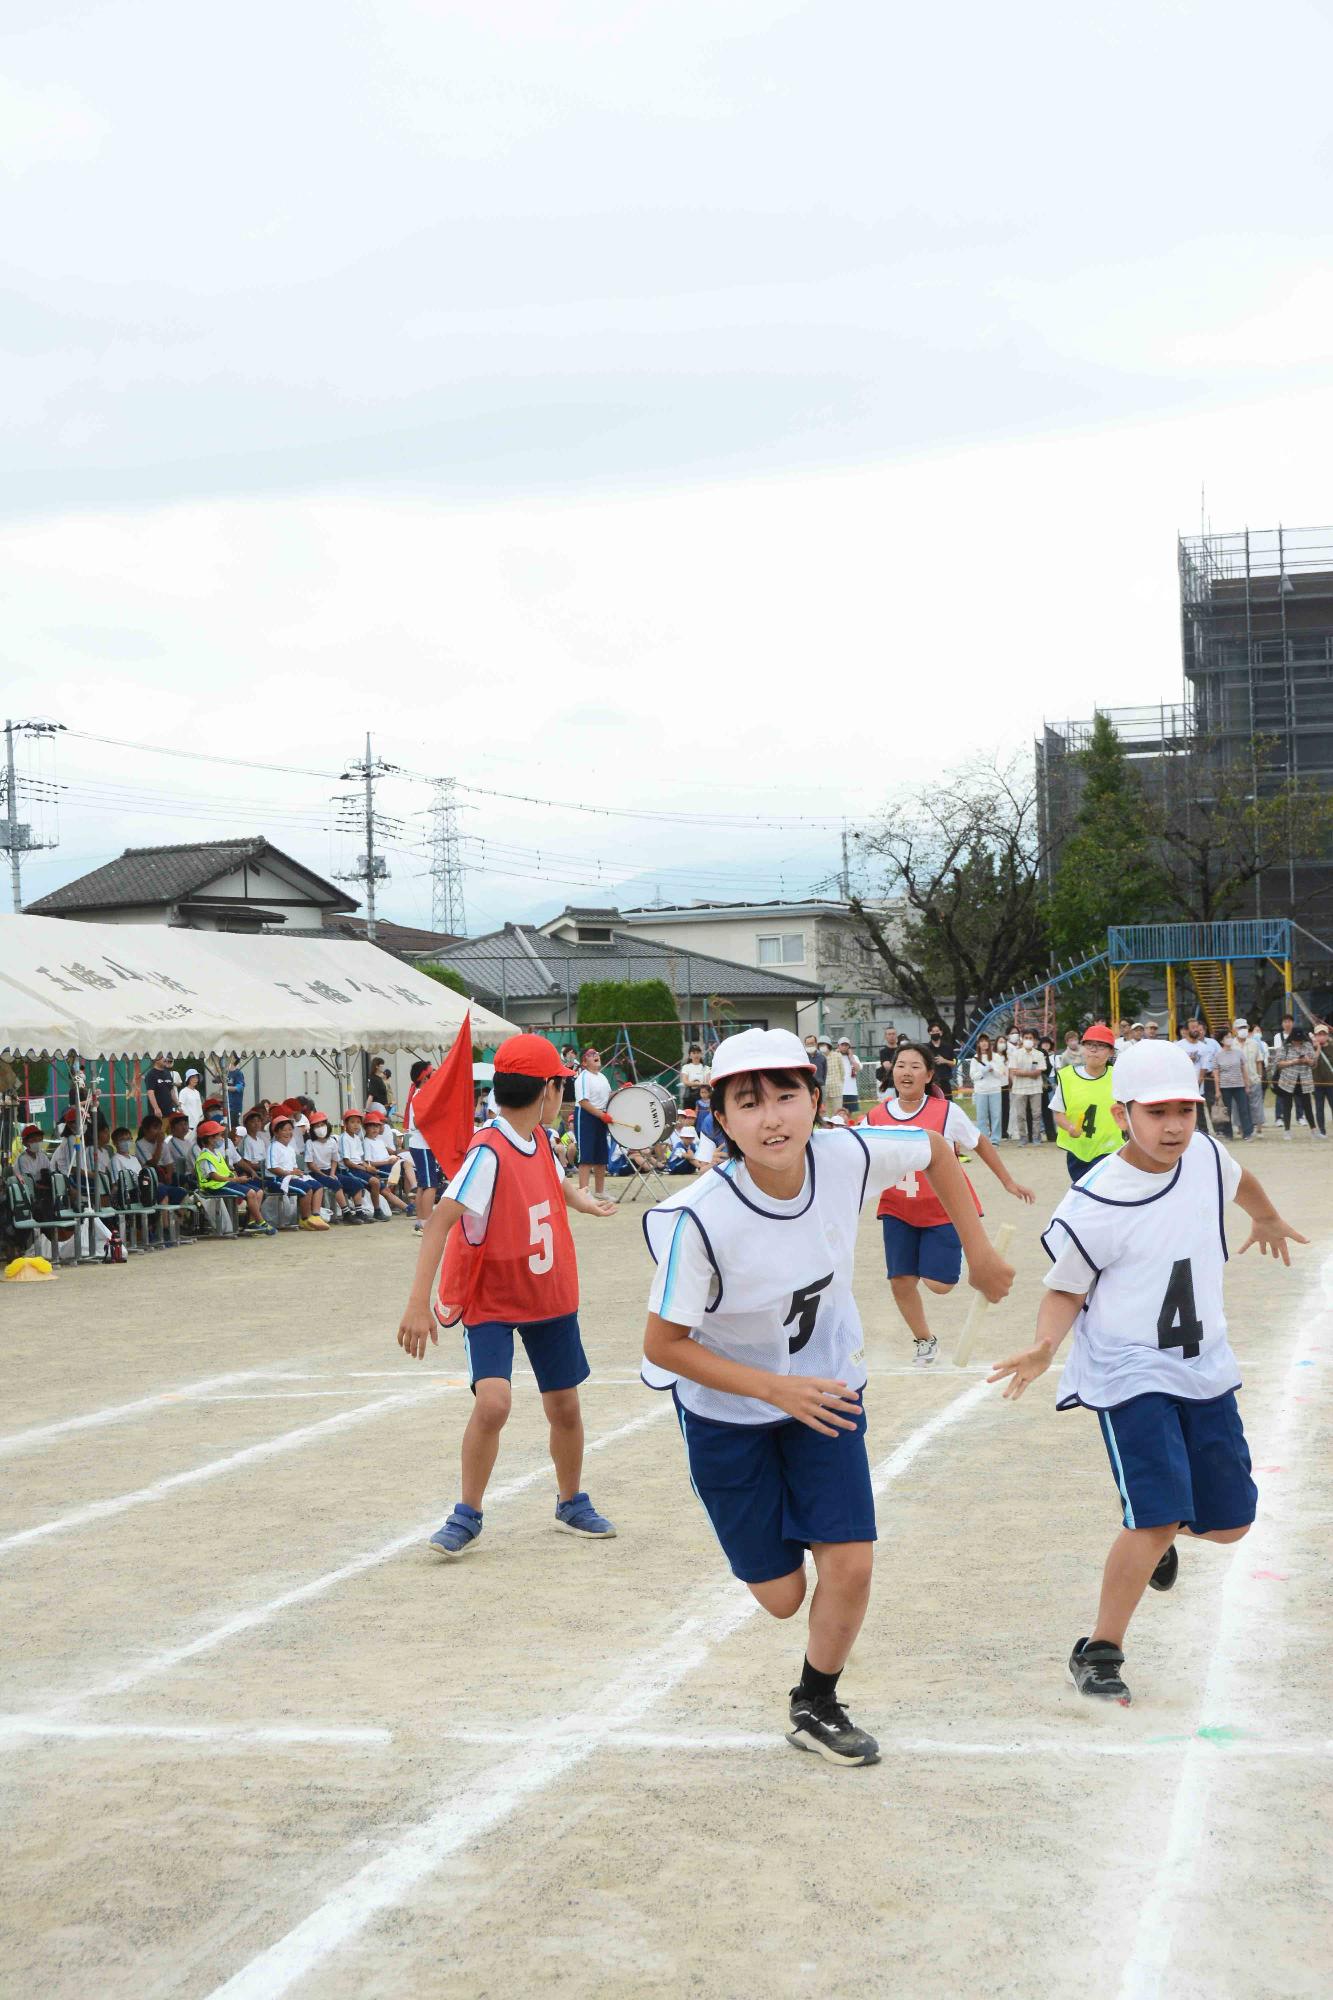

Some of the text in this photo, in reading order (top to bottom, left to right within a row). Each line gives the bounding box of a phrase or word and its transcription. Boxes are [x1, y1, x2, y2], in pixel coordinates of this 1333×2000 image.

[35, 956, 198, 995] 玉幡小校
[274, 978, 432, 1006] 玉幡学校
[649, 1101, 660, 1128] KAWAI
[1082, 1104, 1097, 1138] 4
[528, 1200, 554, 1274] 5
[783, 1271, 834, 1354] 5
[1157, 1258, 1203, 1359] 4
